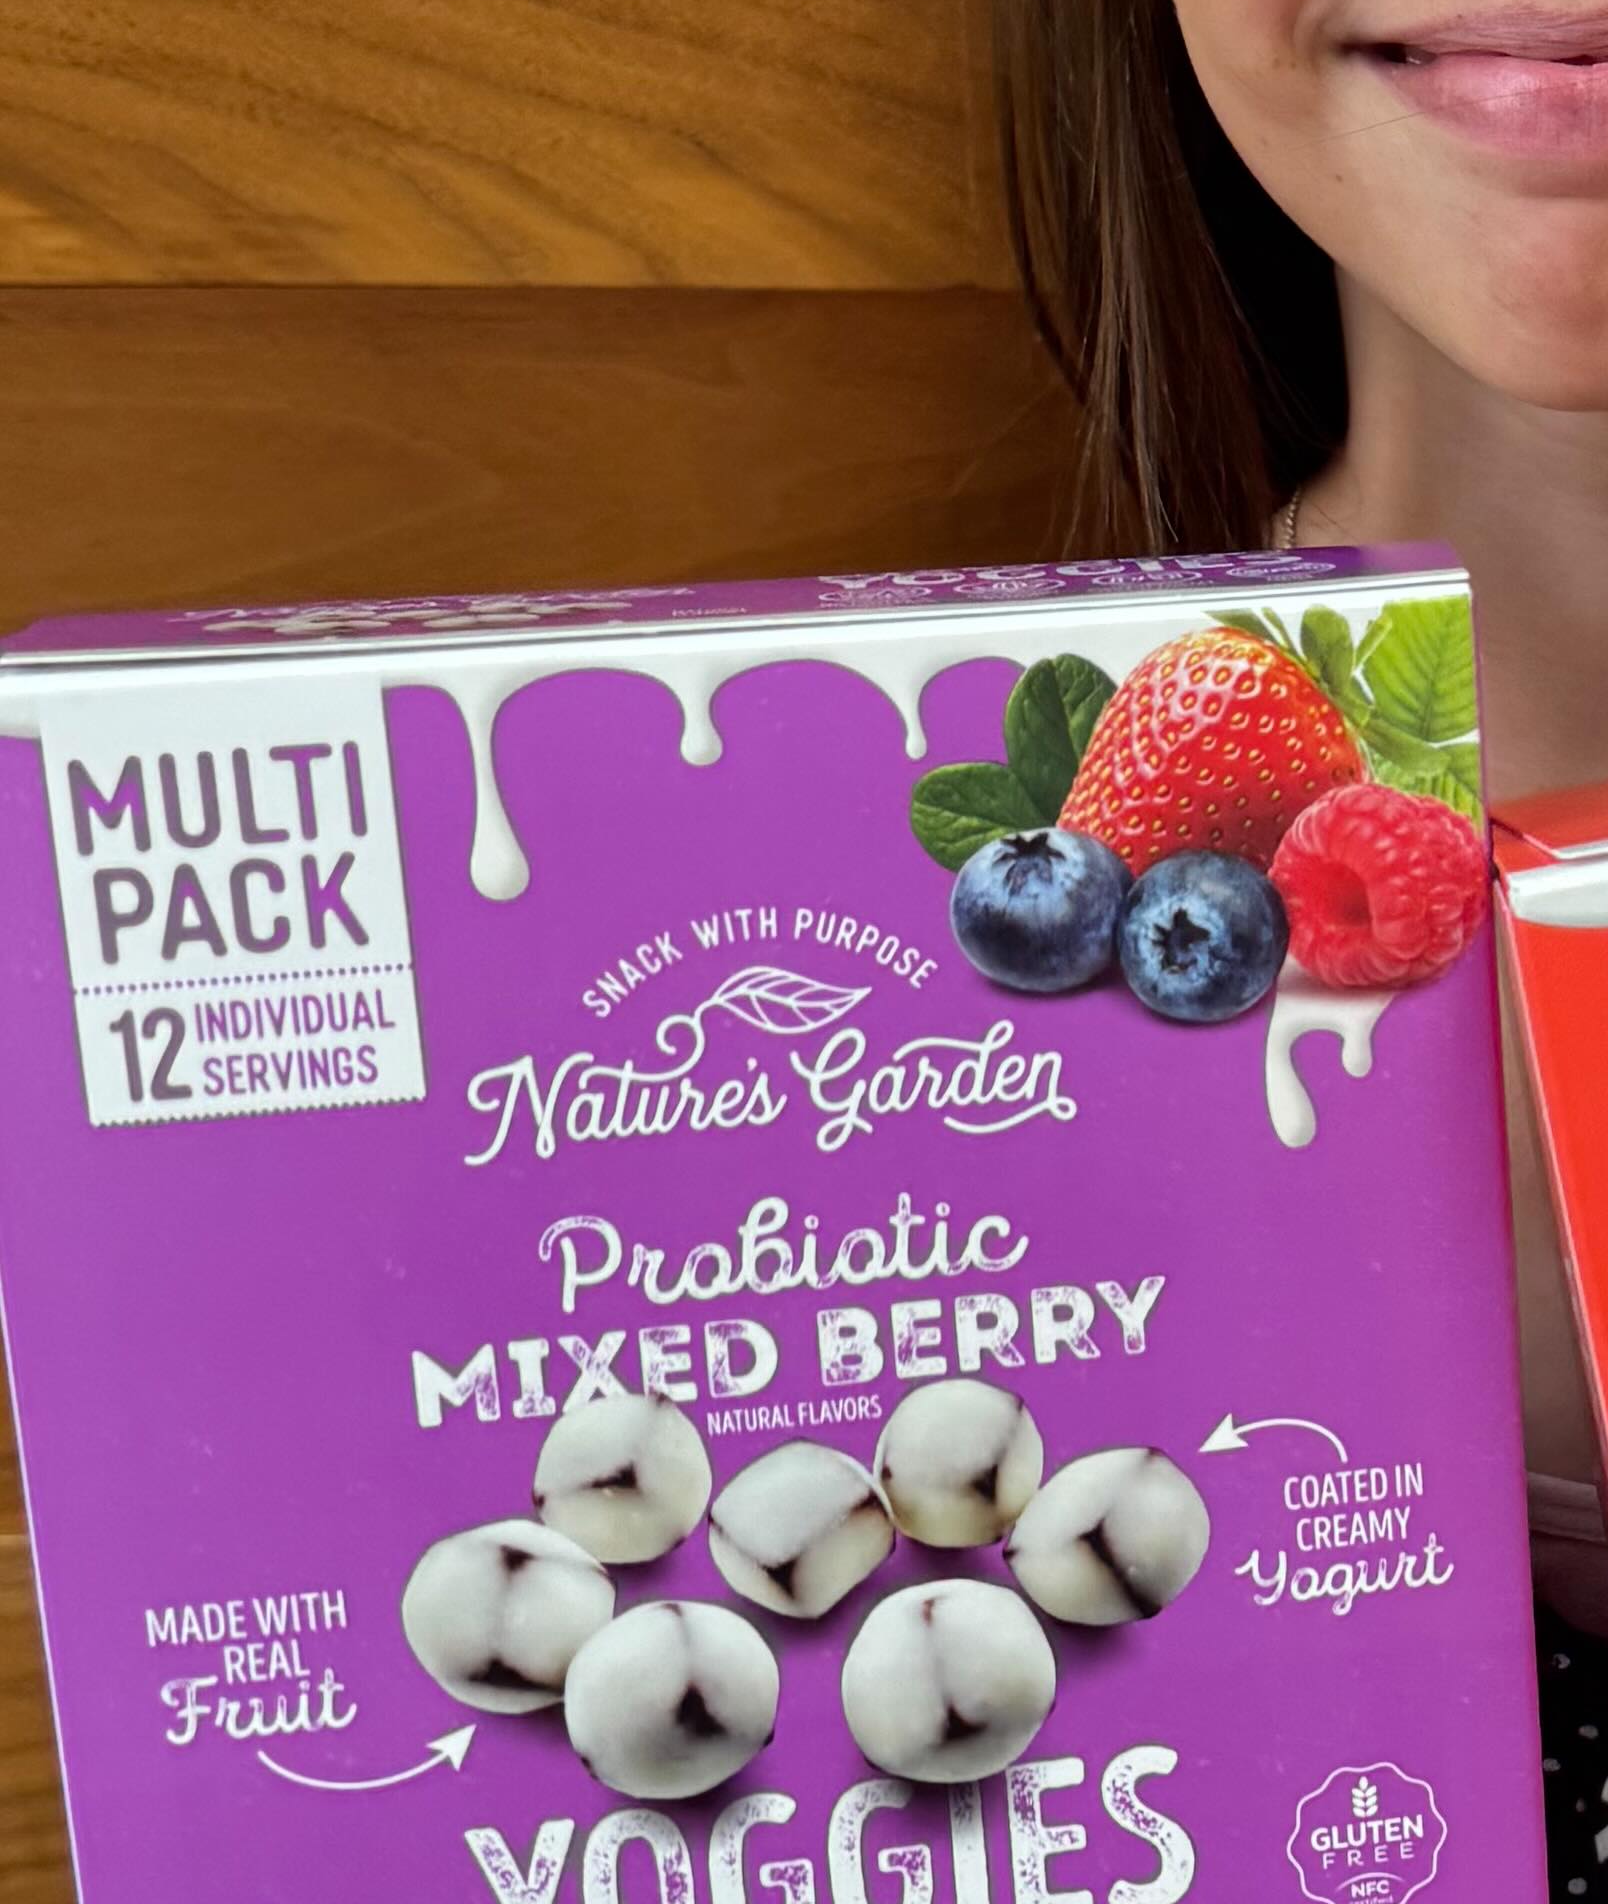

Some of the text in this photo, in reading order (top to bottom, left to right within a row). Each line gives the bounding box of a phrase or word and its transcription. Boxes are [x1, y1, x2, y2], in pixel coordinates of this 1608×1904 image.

[67, 741, 367, 856] MULTI
[93, 852, 369, 964] PACK
[582, 908, 938, 1017] SNACK WITH PURPOSE
[109, 989, 395, 1102] 12 INDIVIDUAL
[202, 1045, 380, 1096] SERVINGS
[464, 1019, 1077, 1167] Nature's Garden
[539, 1192, 1029, 1314] Probiotic
[411, 1275, 1166, 1427] MIXED BERRY
[706, 1395, 883, 1436] NATURAL FLAVORS
[1284, 1462, 1424, 1511] COATED IN
[1296, 1505, 1411, 1552] CREAMY
[1234, 1532, 1455, 1616] Yogurt
[145, 1589, 348, 1647] MADE WITH
[224, 1639, 310, 1684] REAL
[160, 1667, 358, 1745] Fruit
[1311, 1814, 1424, 1851] GLUTEN
[1323, 1842, 1414, 1870] FREE
[1351, 1880, 1390, 1898] NFC
